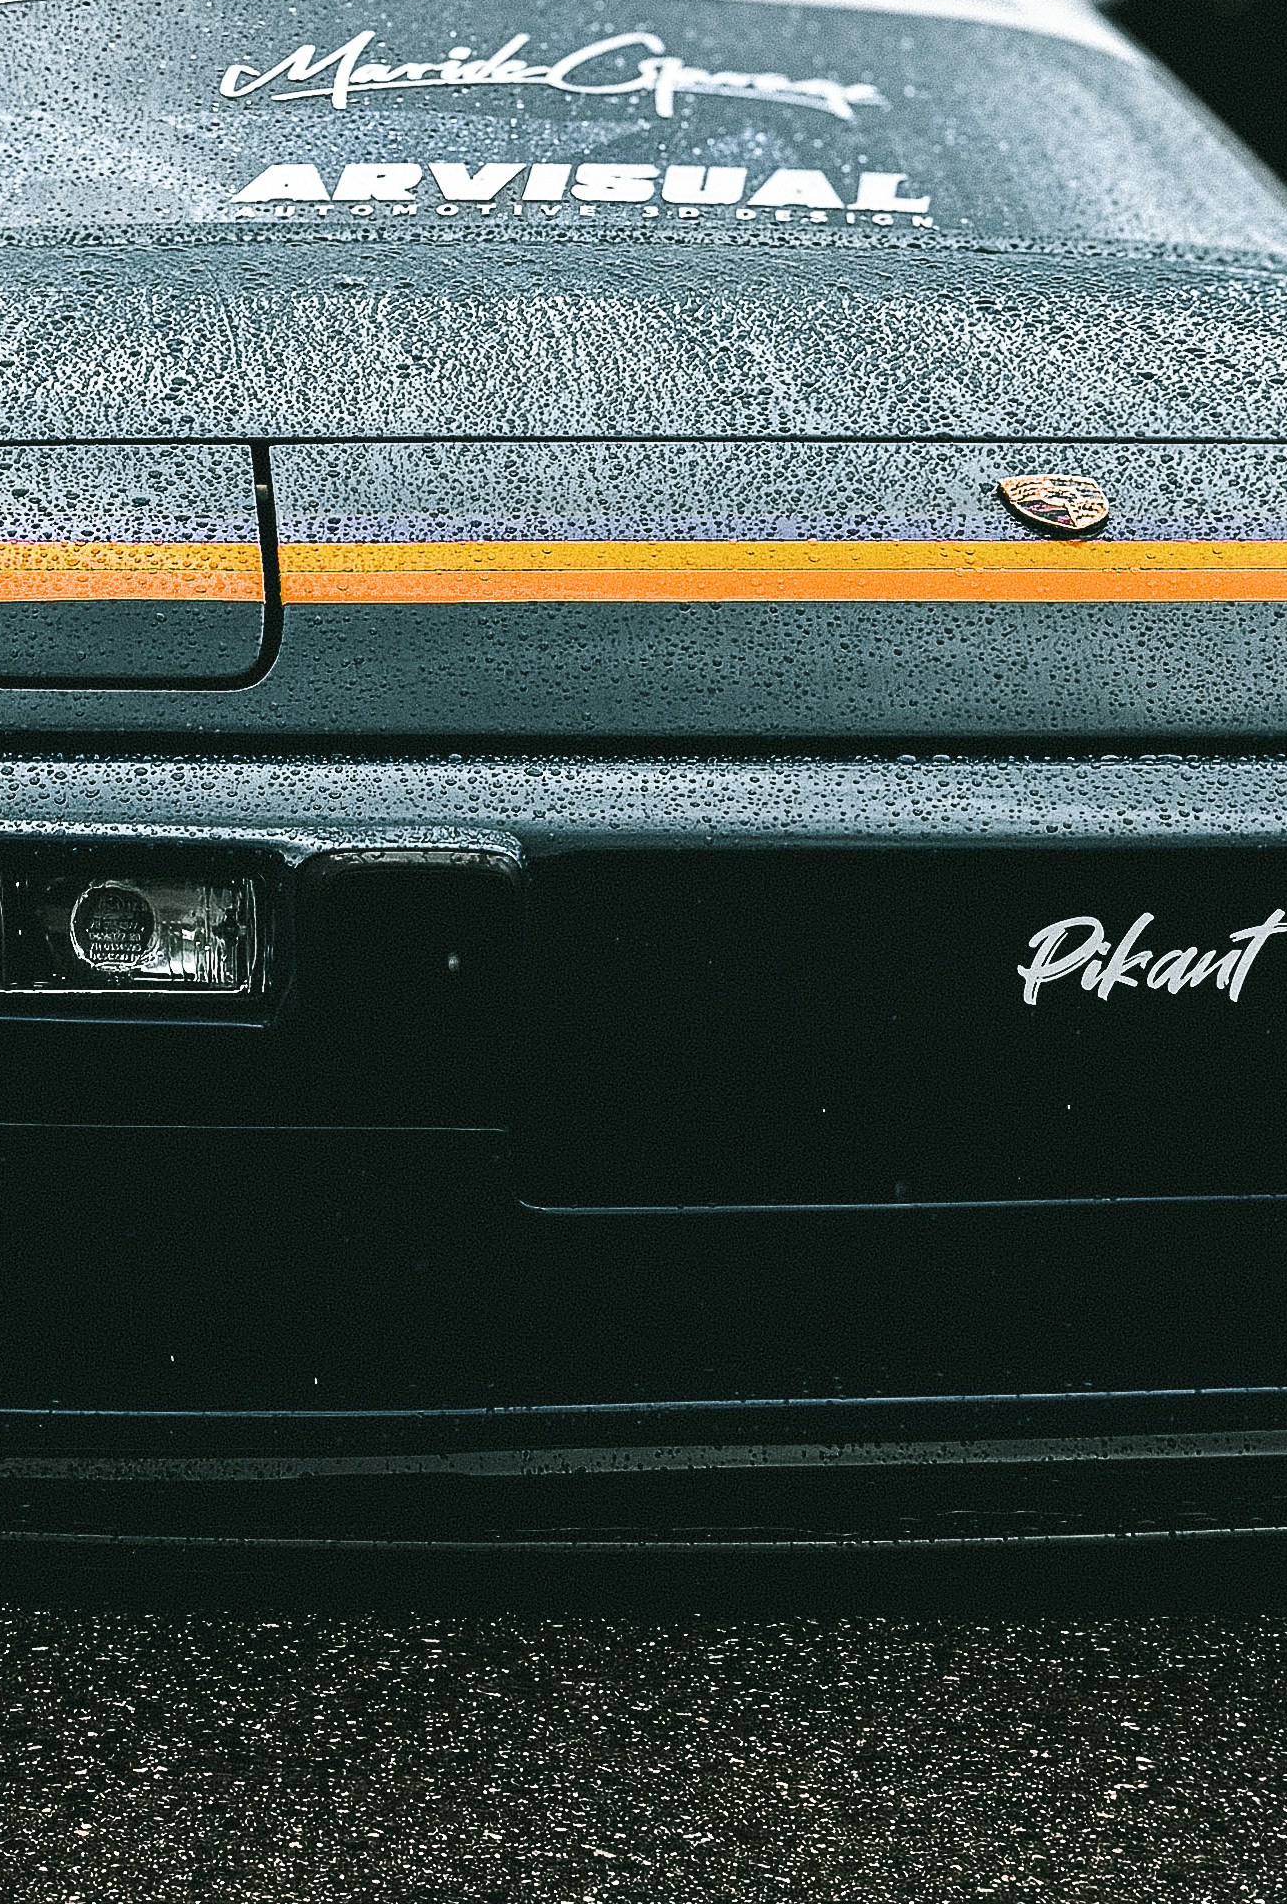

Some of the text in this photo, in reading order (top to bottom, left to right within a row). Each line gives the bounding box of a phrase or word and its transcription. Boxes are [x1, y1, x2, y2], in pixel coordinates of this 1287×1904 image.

[230, 162, 931, 214] ARVISUAL
[235, 202, 597, 219] AUTOMOTIVE
[735, 206, 935, 230] DESIGN
